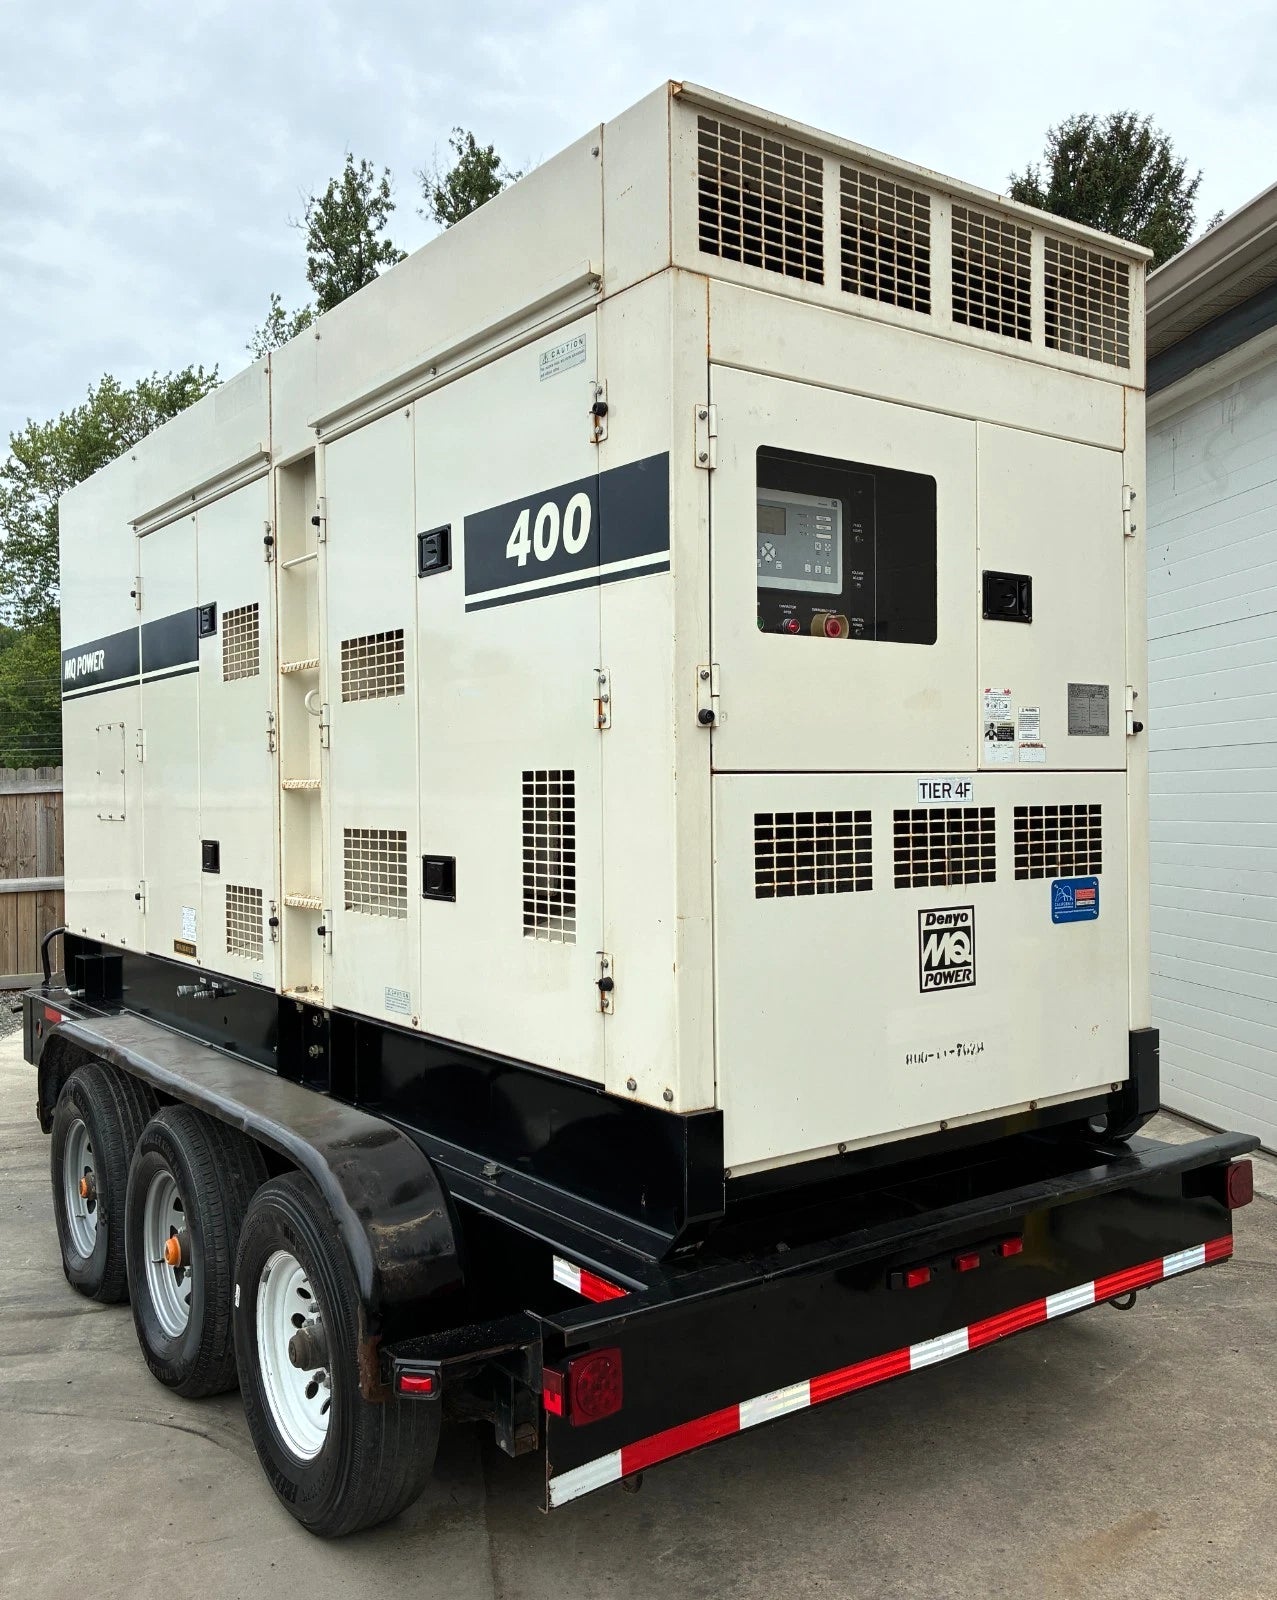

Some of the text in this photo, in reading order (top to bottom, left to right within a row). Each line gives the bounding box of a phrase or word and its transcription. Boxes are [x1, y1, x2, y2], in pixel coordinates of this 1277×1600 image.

[551, 339, 583, 358] CAUTION
[506, 493, 591, 567] 400
[65, 650, 105, 680] MQ POWER
[919, 782, 972, 799] TIER 4F
[925, 912, 969, 926] Denyo
[922, 930, 972, 967] MQ
[924, 968, 972, 987] POWER
